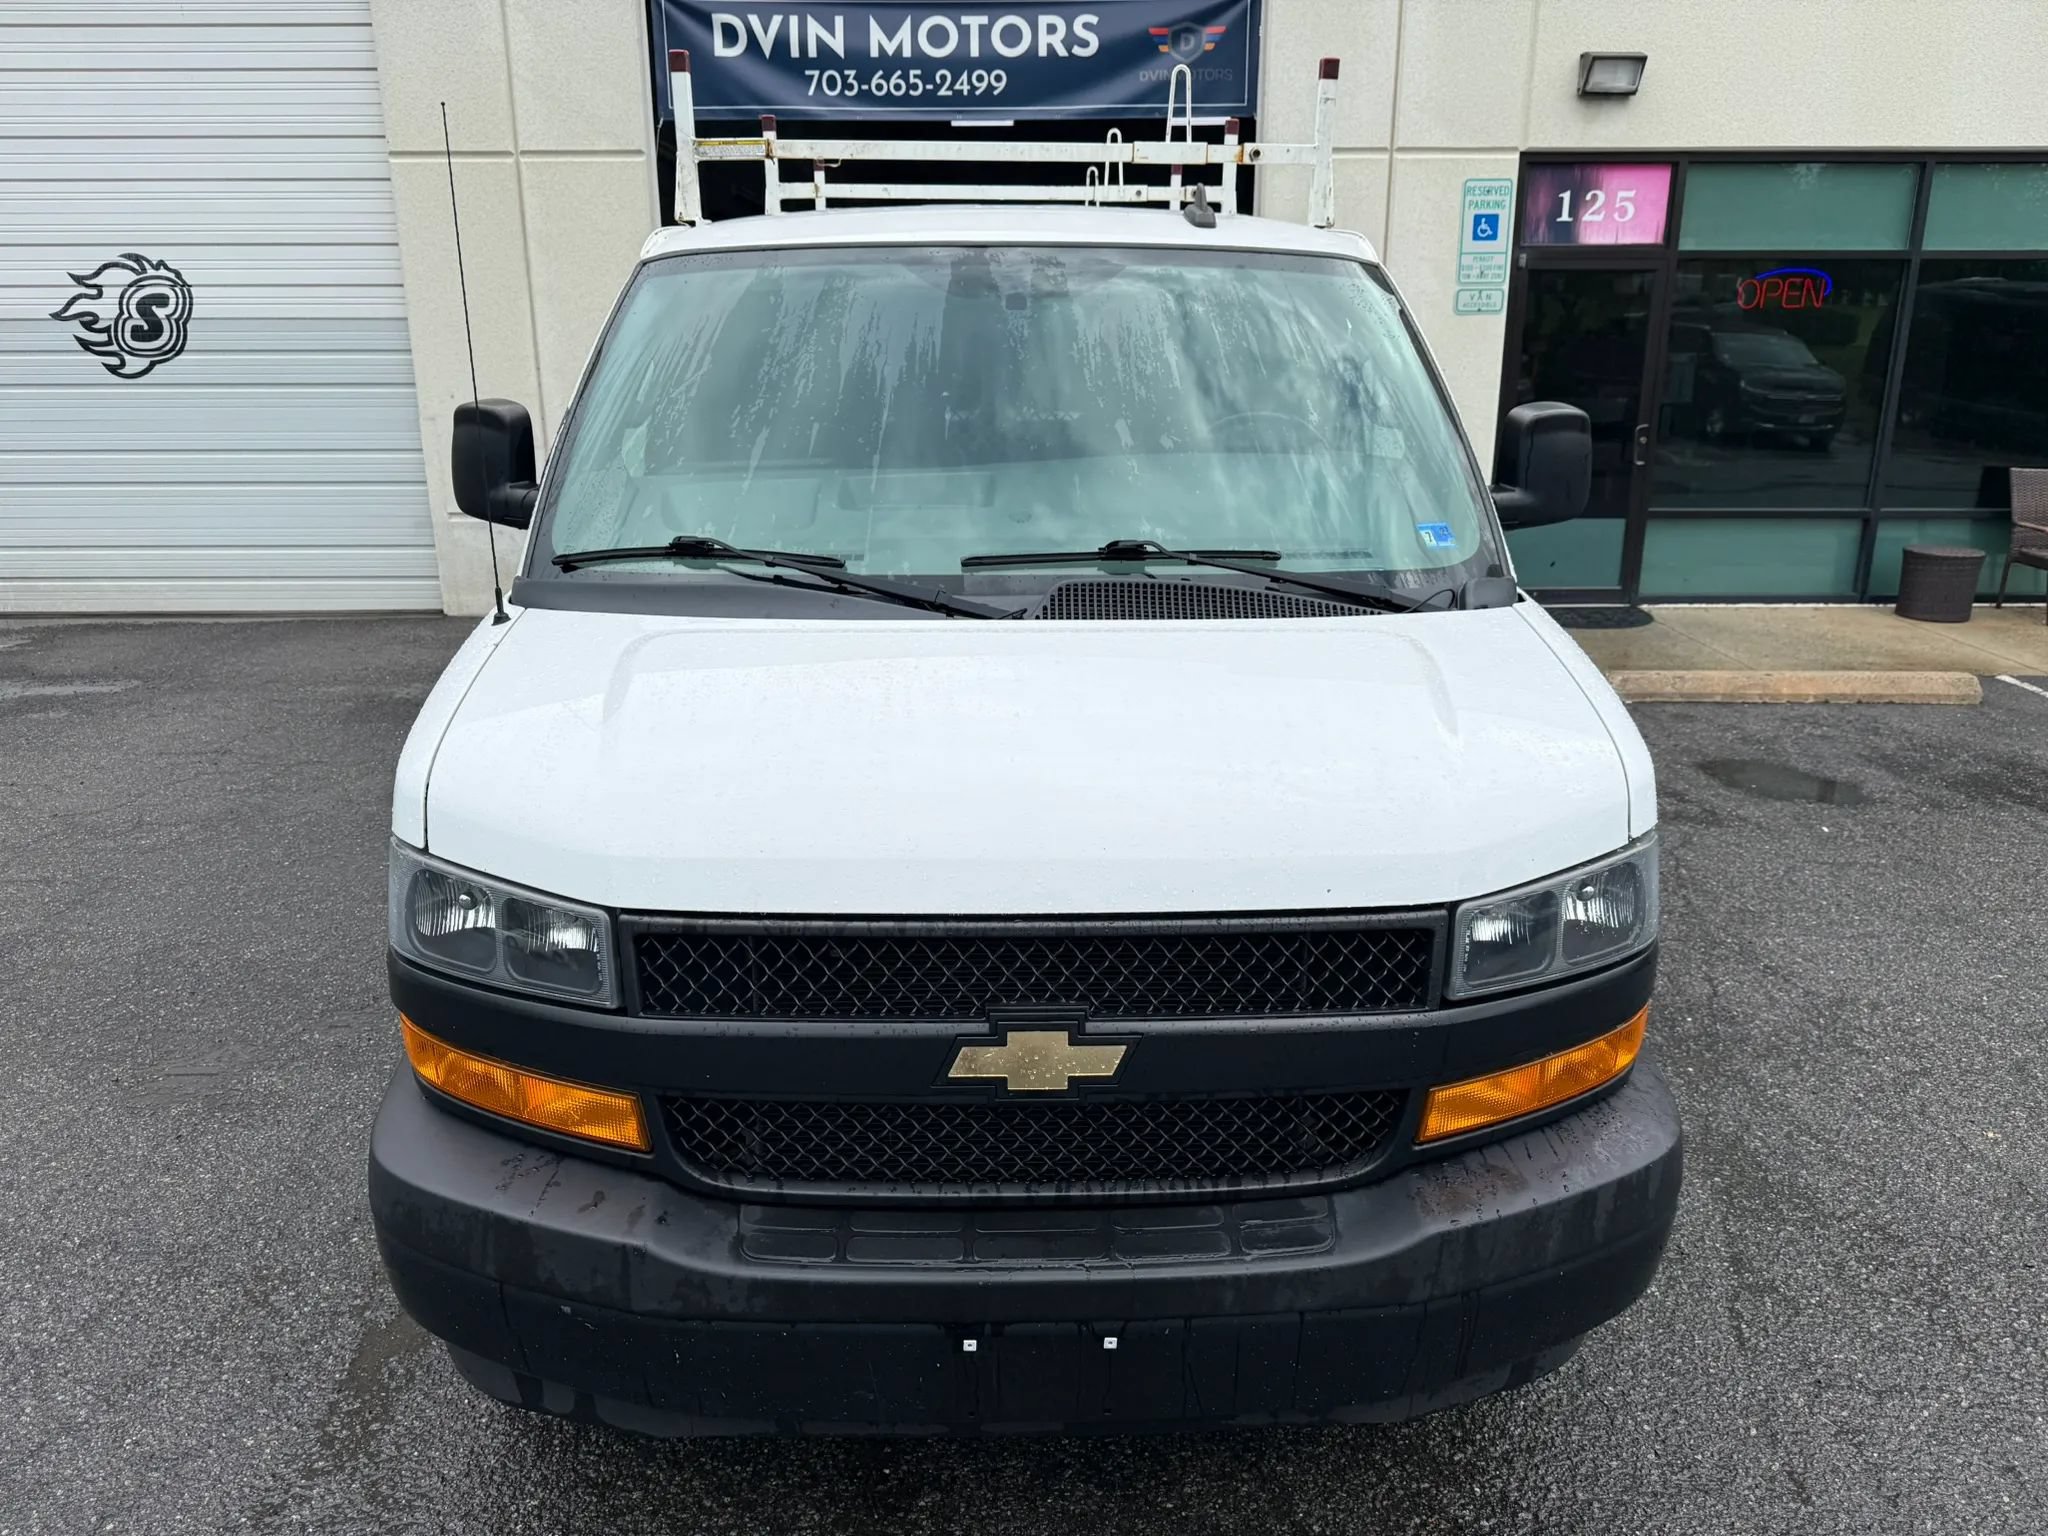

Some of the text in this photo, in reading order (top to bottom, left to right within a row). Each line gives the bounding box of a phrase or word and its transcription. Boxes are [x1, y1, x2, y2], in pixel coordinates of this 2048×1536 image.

[711, 13, 1100, 60] DVIN MOTORS
[804, 69, 1007, 97] 703-665-2499
[1139, 69, 1171, 82] DVIN
[1466, 185, 1510, 197] RESERVED
[1468, 199, 1506, 210] PARKING
[1556, 189, 1637, 222] 125
[1736, 277, 1826, 310] OPEN
